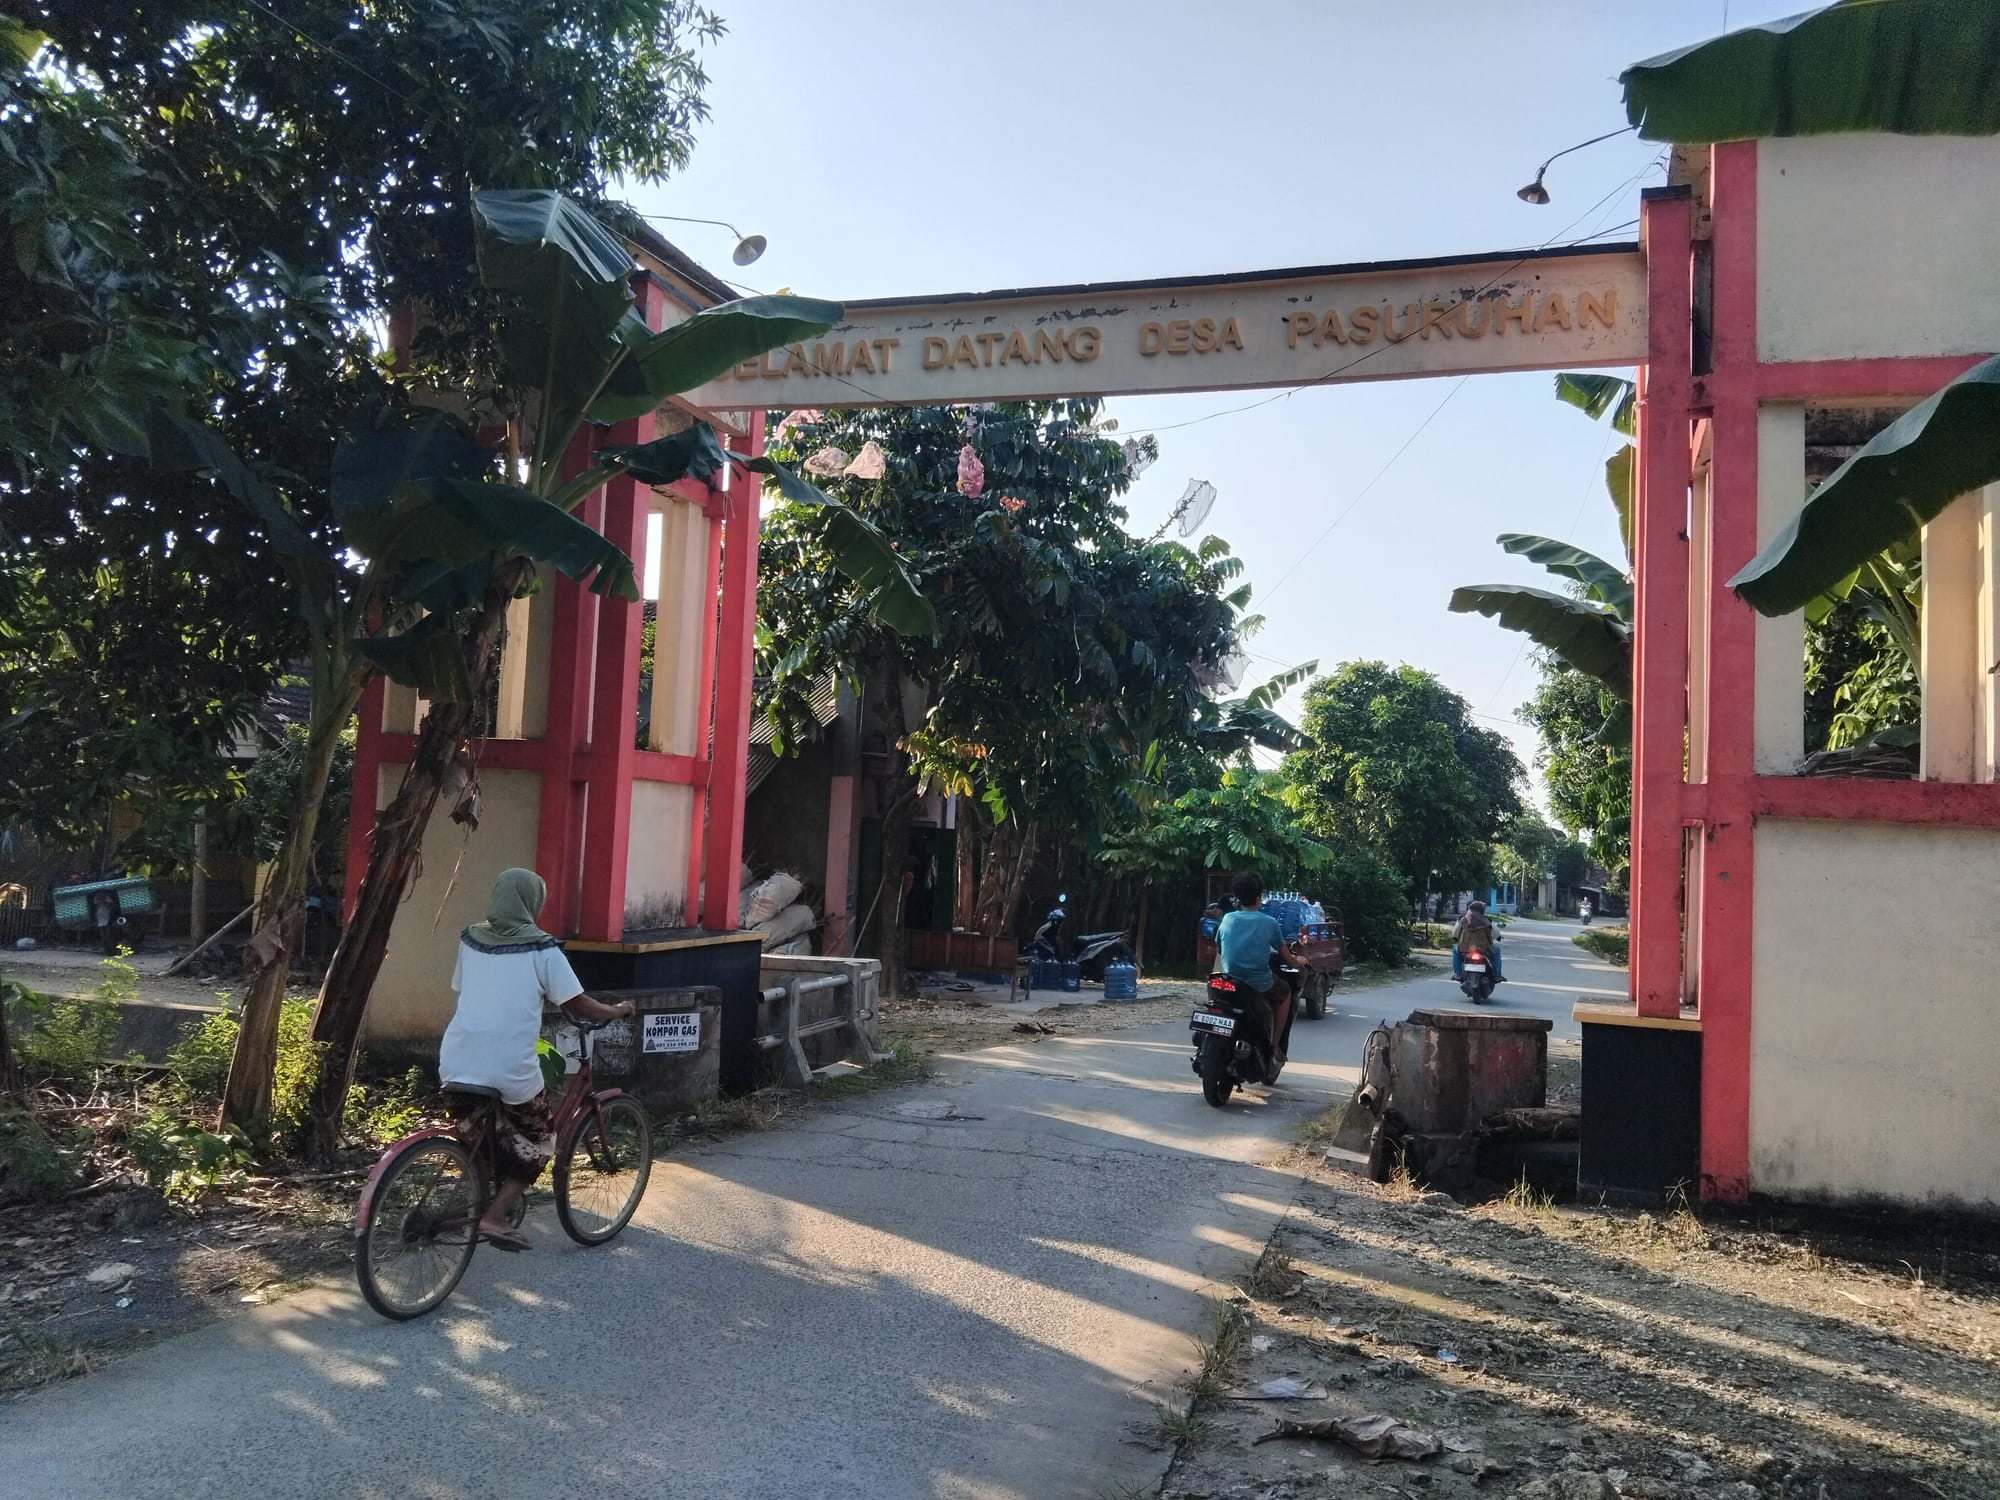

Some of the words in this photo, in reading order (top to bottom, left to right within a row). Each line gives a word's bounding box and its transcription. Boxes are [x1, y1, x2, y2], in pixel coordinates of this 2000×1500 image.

[713, 338, 899, 383] ELAMAT
[922, 326, 1102, 370] DATANG
[1139, 315, 1244, 357] DESA
[1288, 288, 1617, 350] PASURUHAN
[655, 1015, 691, 1025] SERVICE
[646, 1026, 679, 1037] KOMPOR
[681, 1026, 697, 1035] GAS
